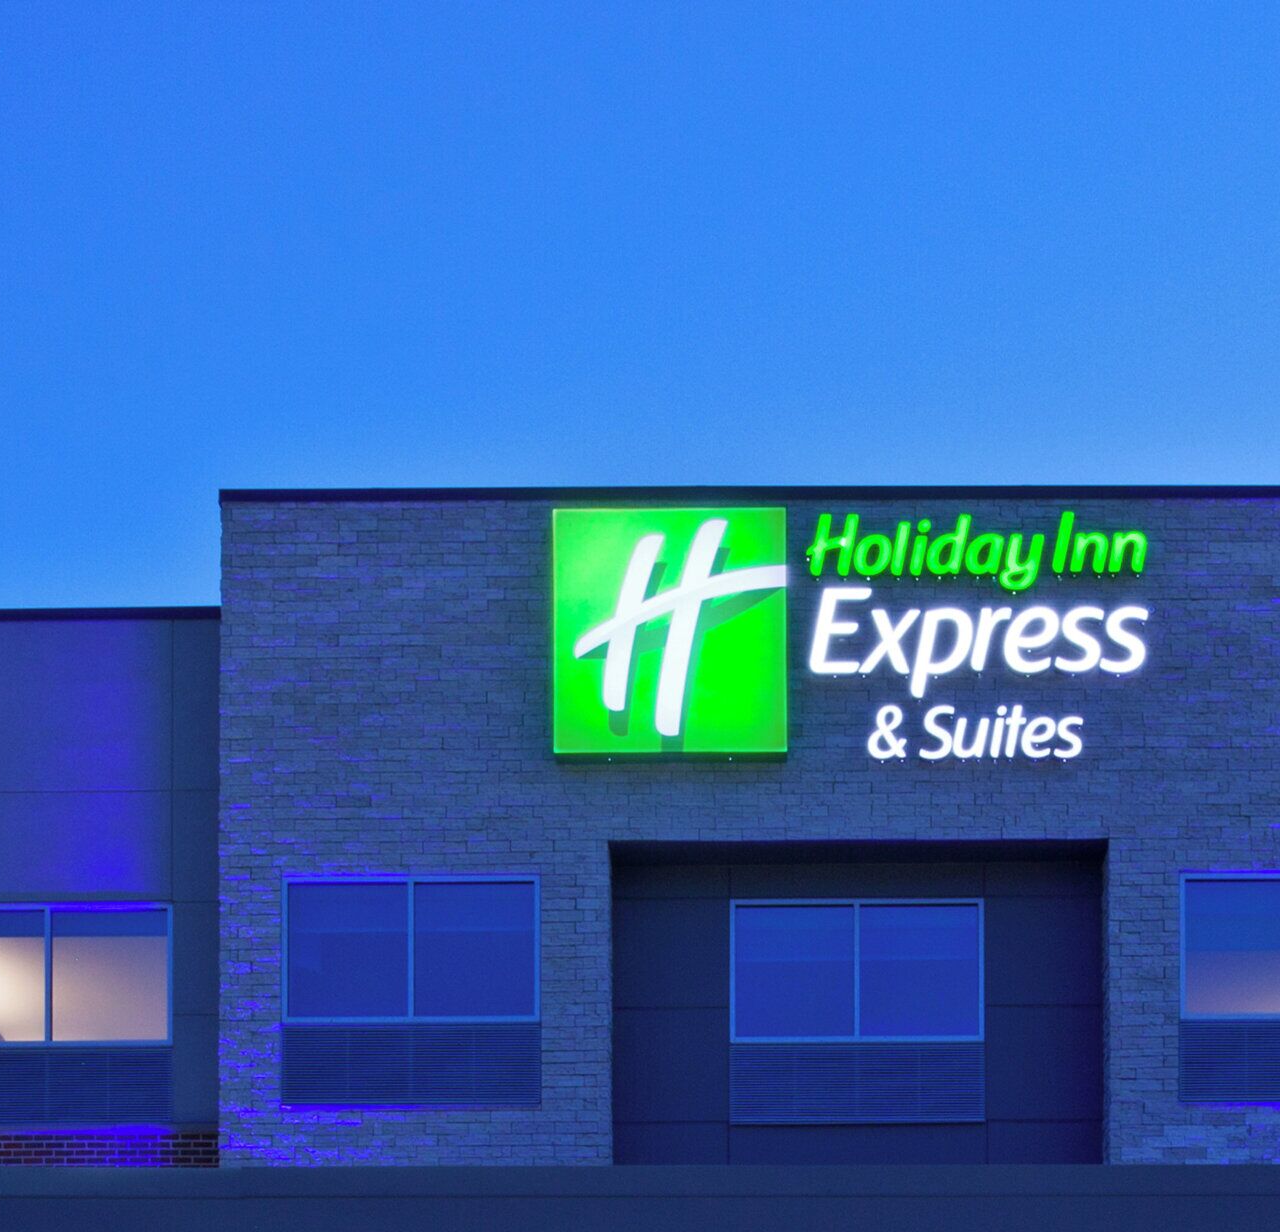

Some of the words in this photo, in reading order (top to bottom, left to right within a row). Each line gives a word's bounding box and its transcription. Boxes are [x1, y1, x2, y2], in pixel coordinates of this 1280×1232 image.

[806, 512, 1045, 592] Holiday
[1051, 511, 1148, 574] Inn
[808, 586, 1149, 699] Express
[867, 704, 907, 760] &
[918, 704, 1084, 760] Suites
